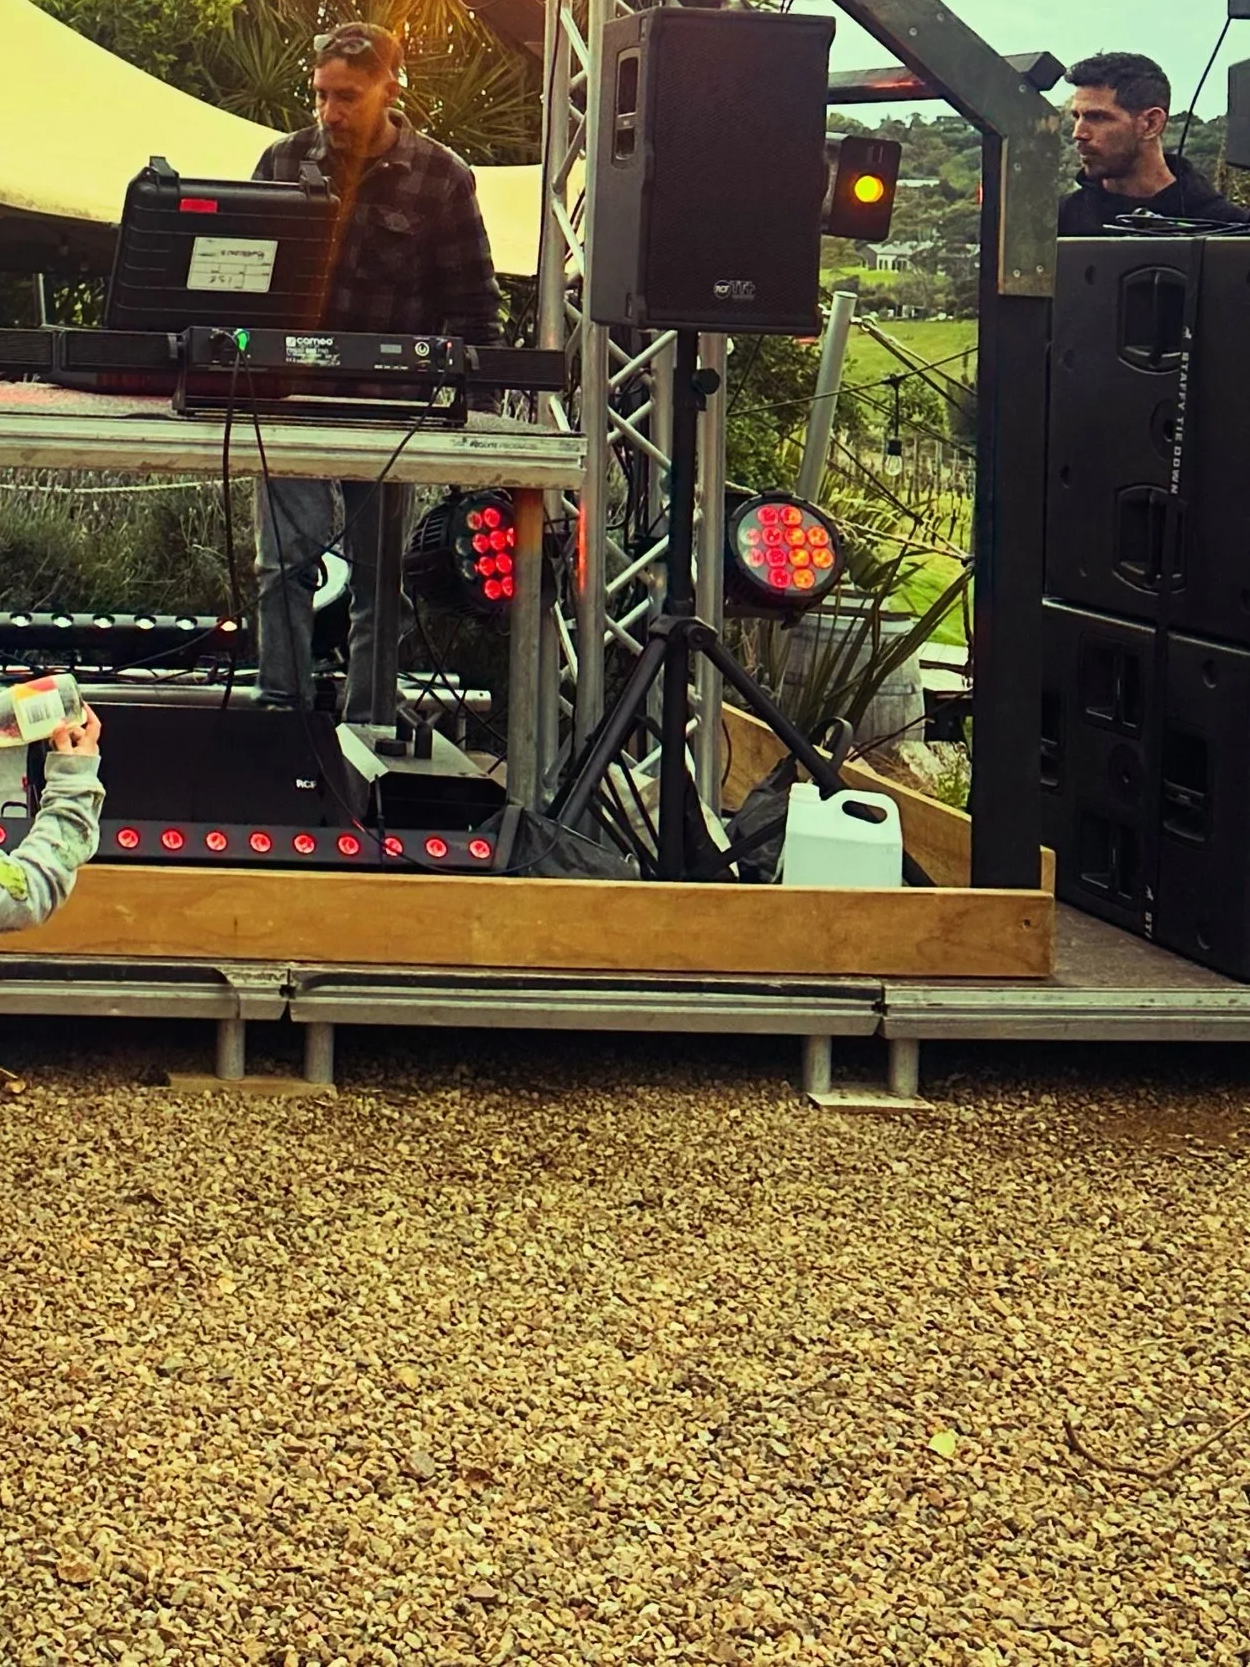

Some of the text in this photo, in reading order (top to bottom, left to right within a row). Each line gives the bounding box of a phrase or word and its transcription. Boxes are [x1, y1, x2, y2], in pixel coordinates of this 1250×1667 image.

[296, 337, 333, 346] cameo
[1174, 417, 1185, 442] TIE
[1170, 446, 1182, 494] DOWN
[296, 779, 317, 789] RCF
